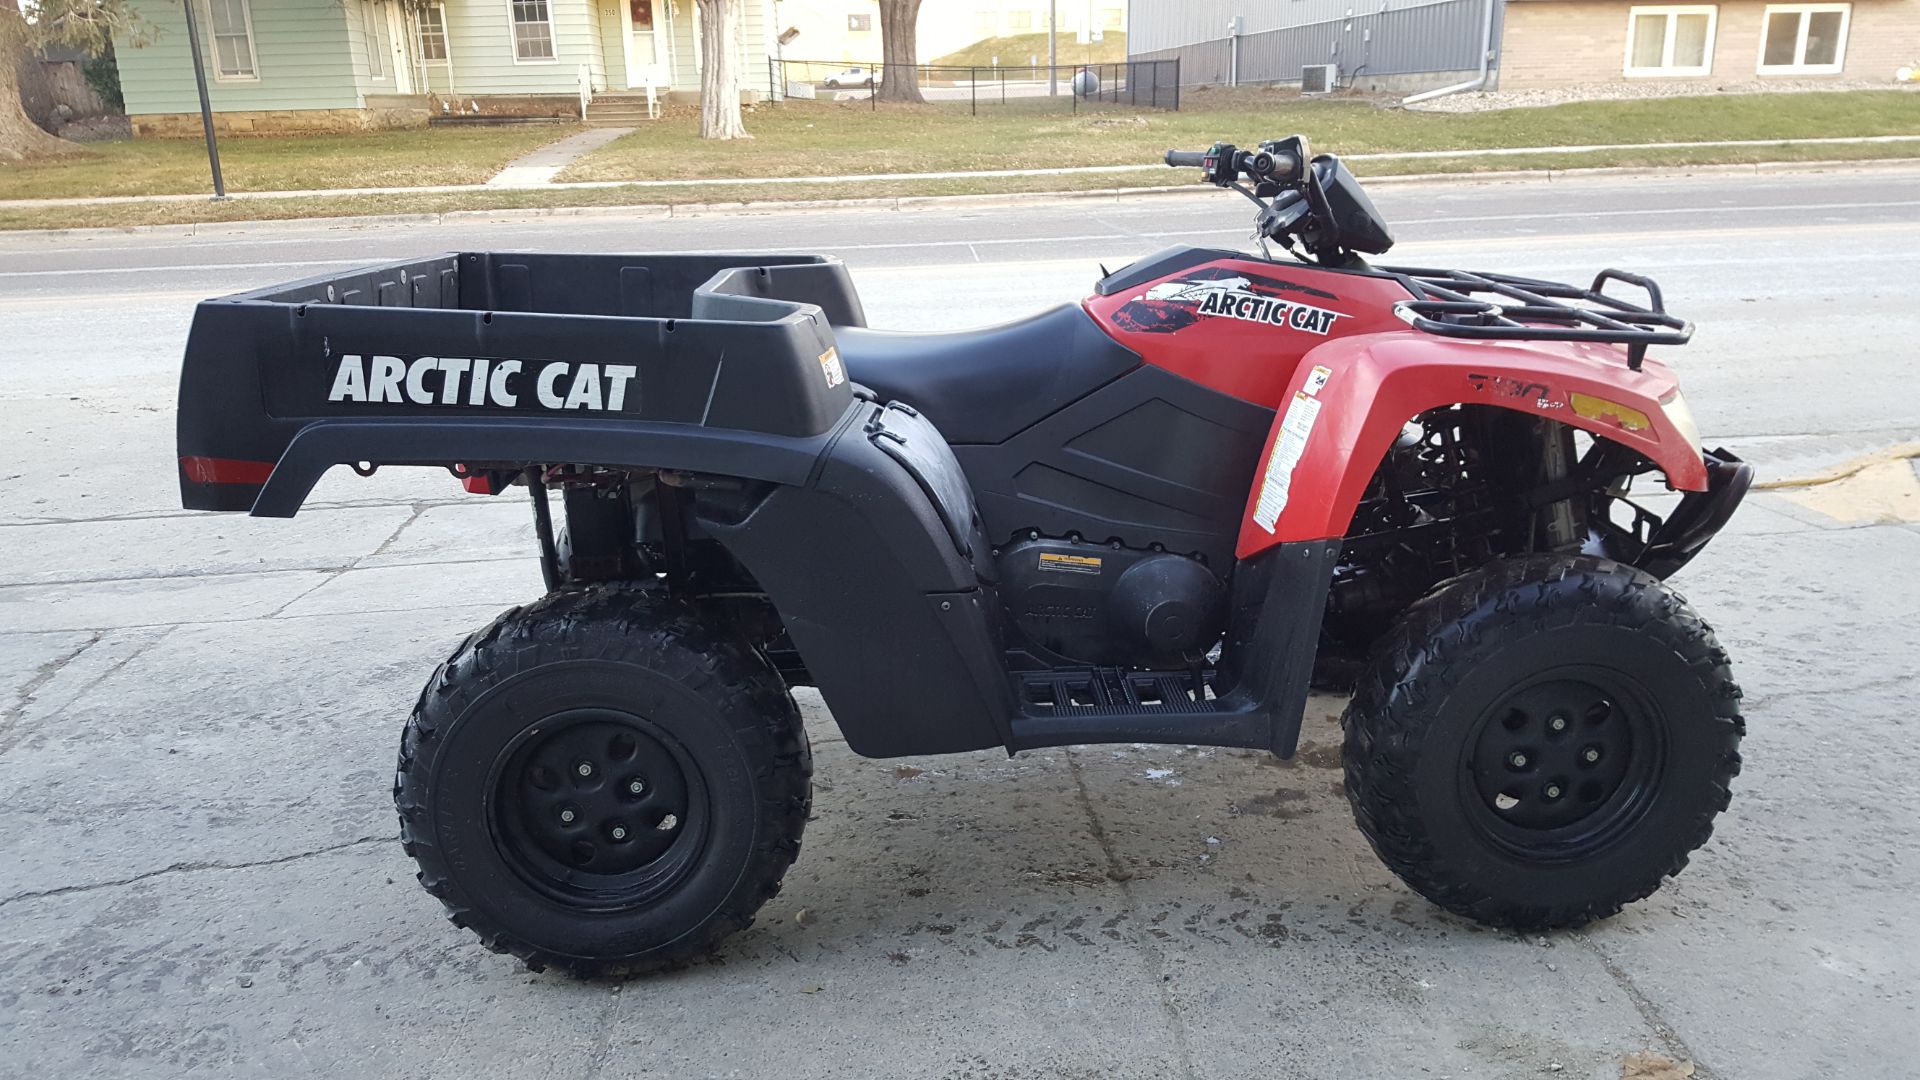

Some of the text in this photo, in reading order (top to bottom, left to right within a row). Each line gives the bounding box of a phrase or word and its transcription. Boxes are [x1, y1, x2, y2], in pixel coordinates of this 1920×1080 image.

[1199, 293, 1337, 335] ARCTIC CAT
[328, 354, 637, 411] ARCTIC CAT
